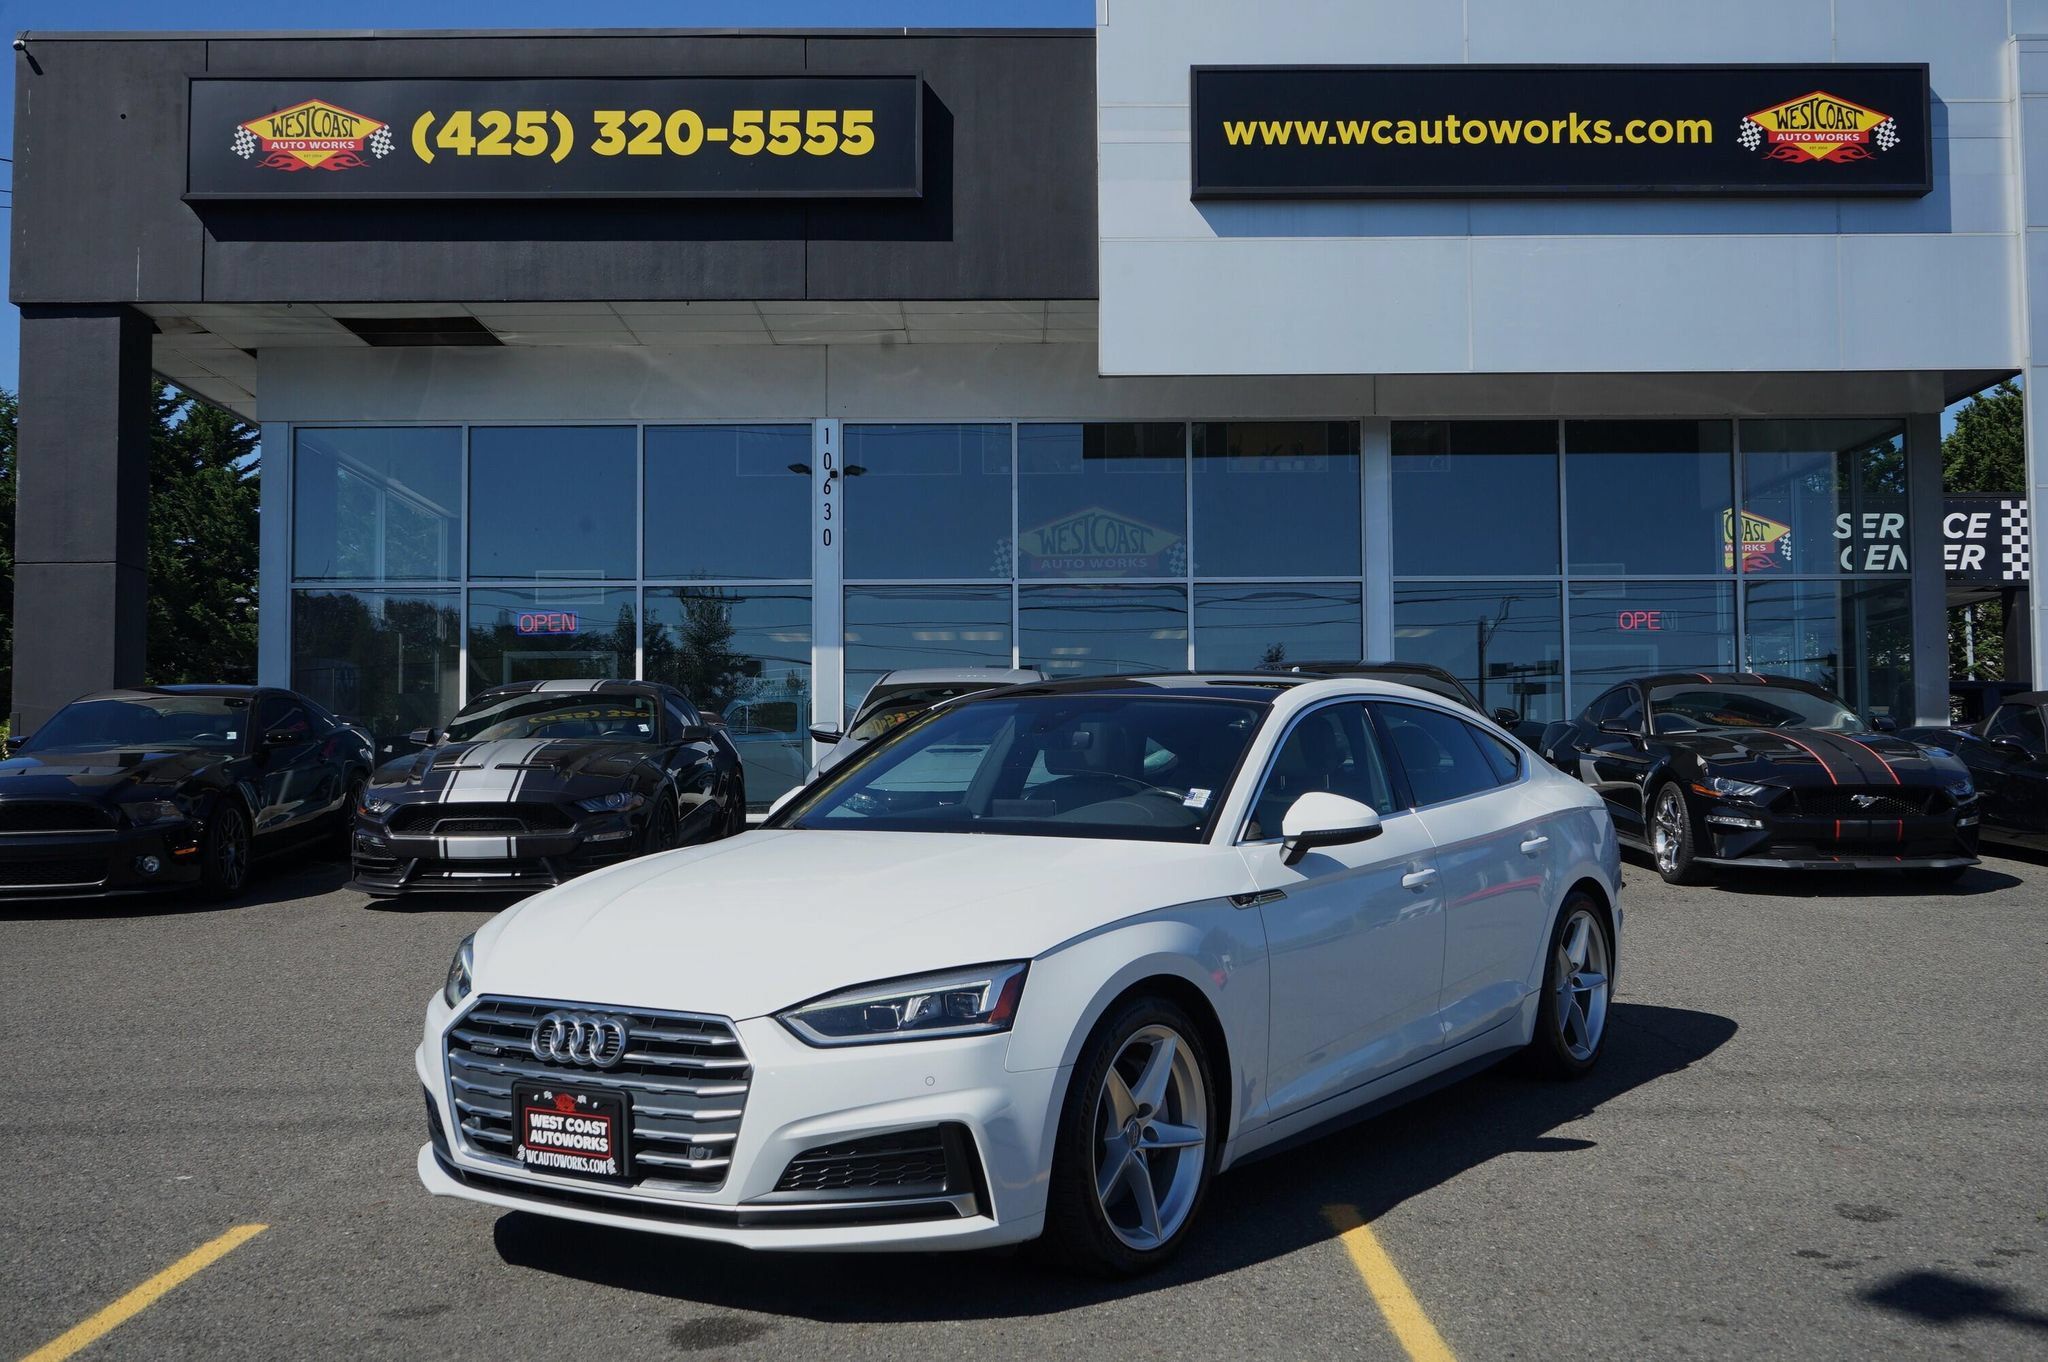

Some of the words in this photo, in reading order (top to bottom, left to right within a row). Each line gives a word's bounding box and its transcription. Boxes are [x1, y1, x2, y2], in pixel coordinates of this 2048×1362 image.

[411, 110, 574, 164] (425)
[590, 109, 875, 156] 320-5555
[1223, 111, 1713, 145] www.wcautoworks.com
[1776, 133, 1811, 141] AUTO
[1814, 133, 1860, 141] WORKS
[271, 141, 306, 149] AUTO
[310, 141, 355, 149] WORKS
[1832, 512, 1992, 540] SERCE
[1041, 558, 1083, 569] AUTO
[1088, 558, 1148, 568] WORKS
[1840, 544, 1986, 571] CENER
[520, 613, 575, 632] OPEN
[530, 1113, 564, 1130] WEST
[565, 1118, 607, 1136] COAST
[530, 1129, 608, 1152] AUTOWORKS
[526, 1149, 607, 1174] WCAUTOWORKS.COM
